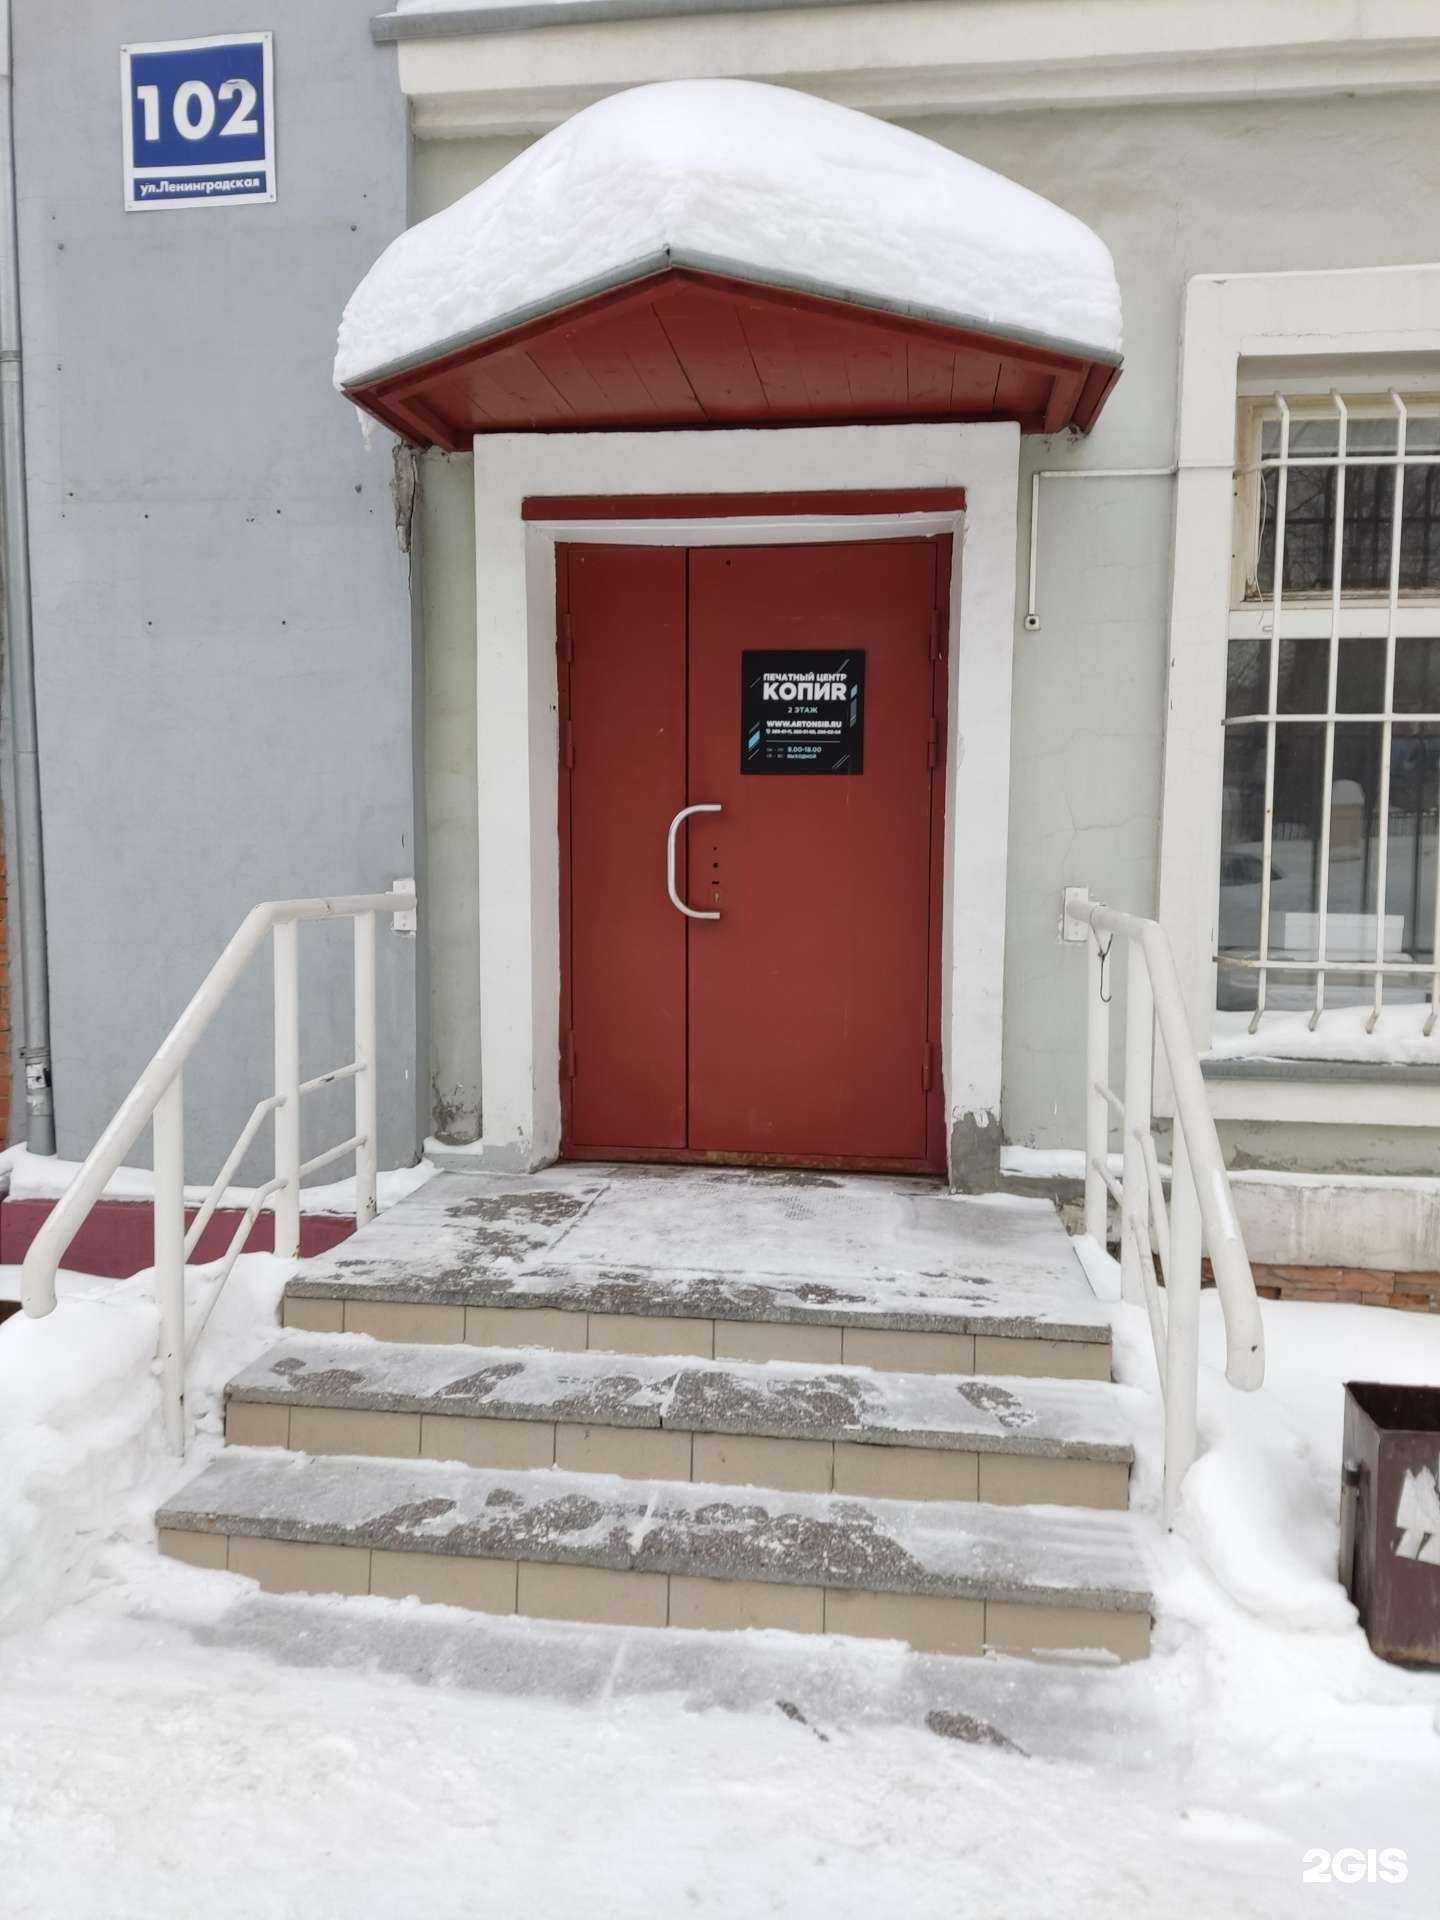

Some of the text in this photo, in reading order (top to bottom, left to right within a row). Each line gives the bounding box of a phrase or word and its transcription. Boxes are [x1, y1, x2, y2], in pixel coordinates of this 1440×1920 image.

[137, 78, 258, 141] 102
[140, 177, 260, 196] ул.Ленинградская
[763, 672, 847, 682] ПЕЧАТНЫЙ ЦЕНТР
[763, 682, 847, 701] КОПИR
